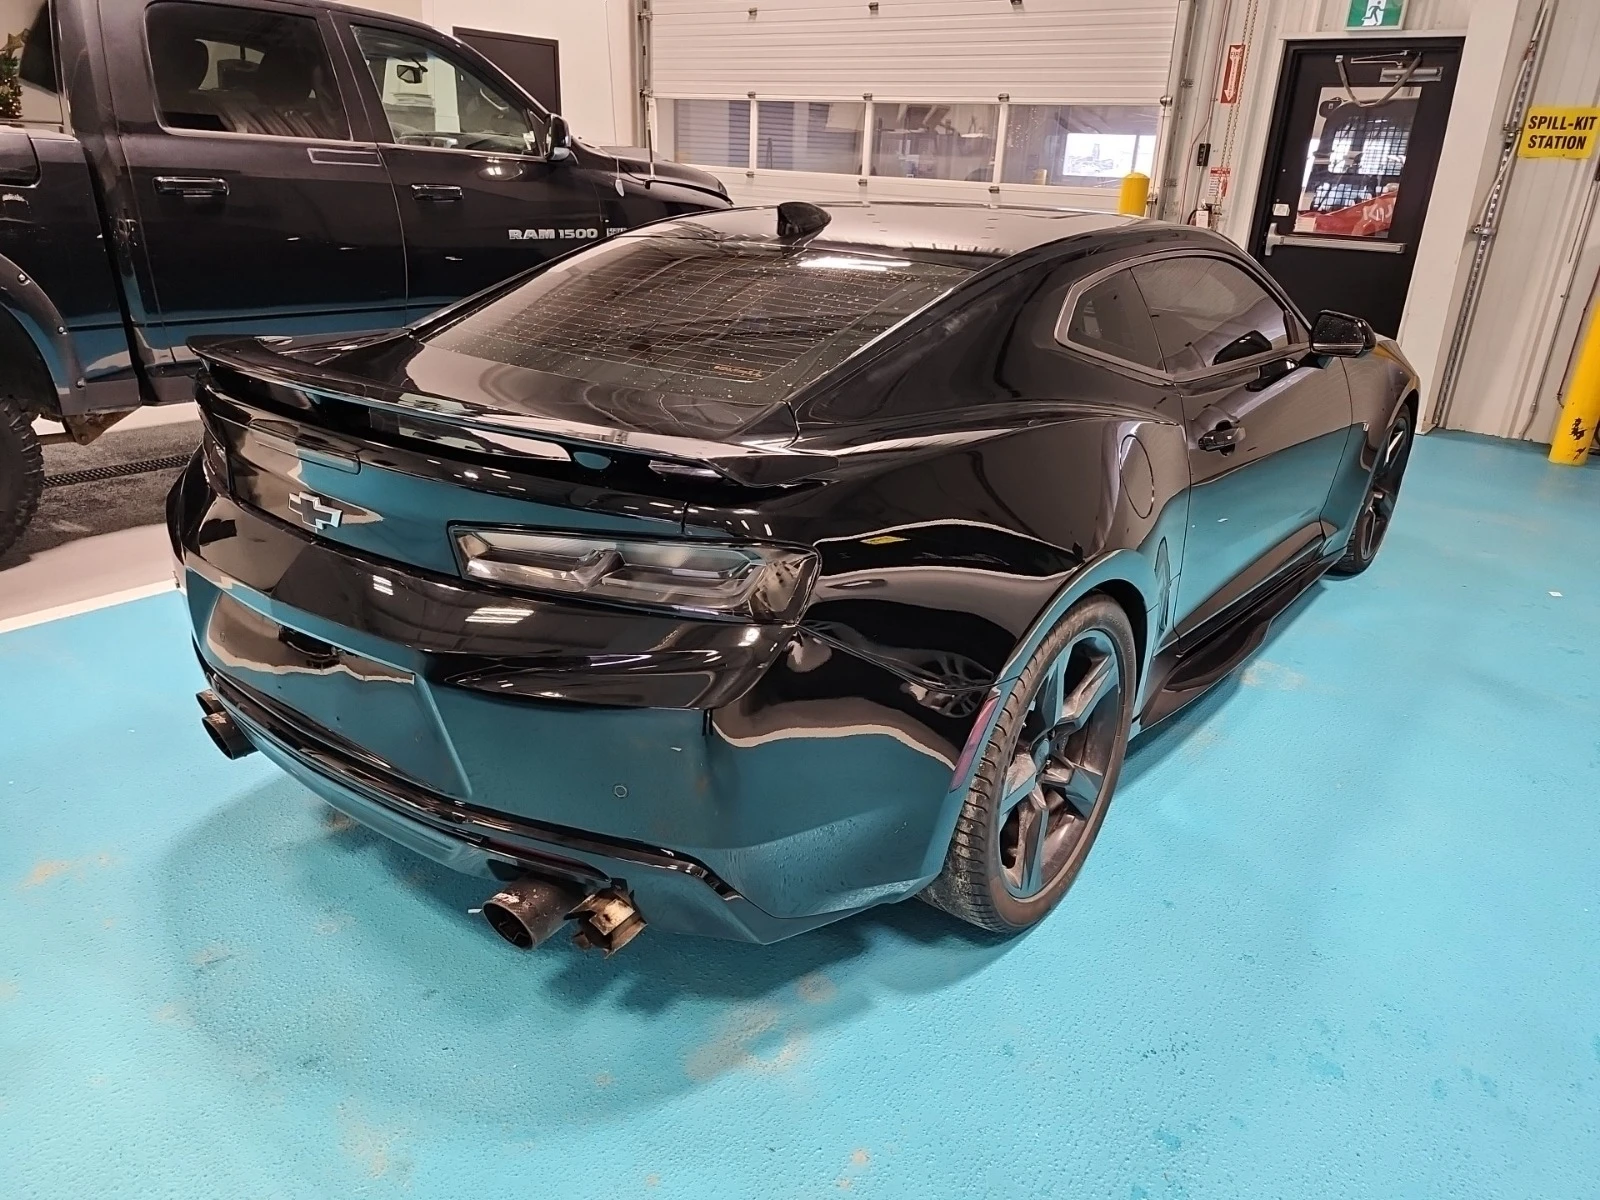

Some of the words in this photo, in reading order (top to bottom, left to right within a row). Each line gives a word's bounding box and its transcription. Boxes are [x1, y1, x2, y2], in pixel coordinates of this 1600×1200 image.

[1528, 115, 1598, 130] SPILL-KIT
[1528, 134, 1587, 150] STATION
[508, 229, 555, 240] RAM
[558, 228, 598, 239] 1500
